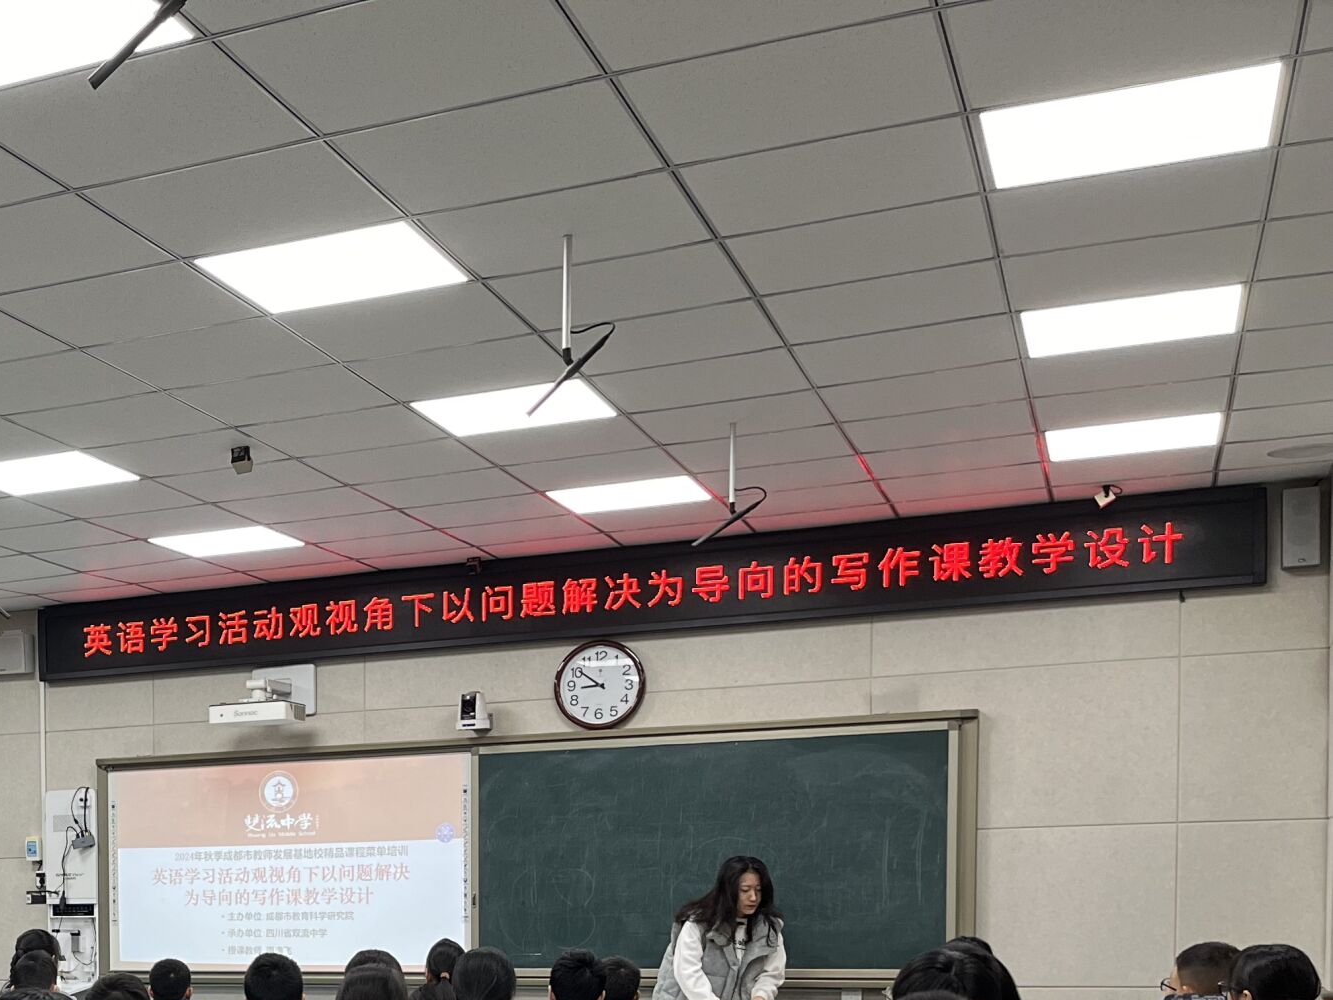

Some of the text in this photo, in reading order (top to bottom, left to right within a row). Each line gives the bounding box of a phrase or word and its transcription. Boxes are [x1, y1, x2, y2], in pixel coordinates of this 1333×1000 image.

[82, 521, 1184, 658] 英语学习活动观视角下以问题解决为导向的写作课教学设计
[595, 651, 607, 661] 12
[571, 667, 583, 678] 10
[622, 664, 631, 675] 2
[567, 681, 576, 691] 9
[624, 679, 633, 690] 3
[570, 695, 578, 706] 8
[620, 693, 629, 705] 4
[581, 707, 589, 717] 7
[594, 708, 603, 719] 6
[610, 706, 618, 717] 5
[152, 863, 410, 885] 英语学习活动观视角下以问题解决
[184, 887, 374, 906] 为导向的写作课教学设计
